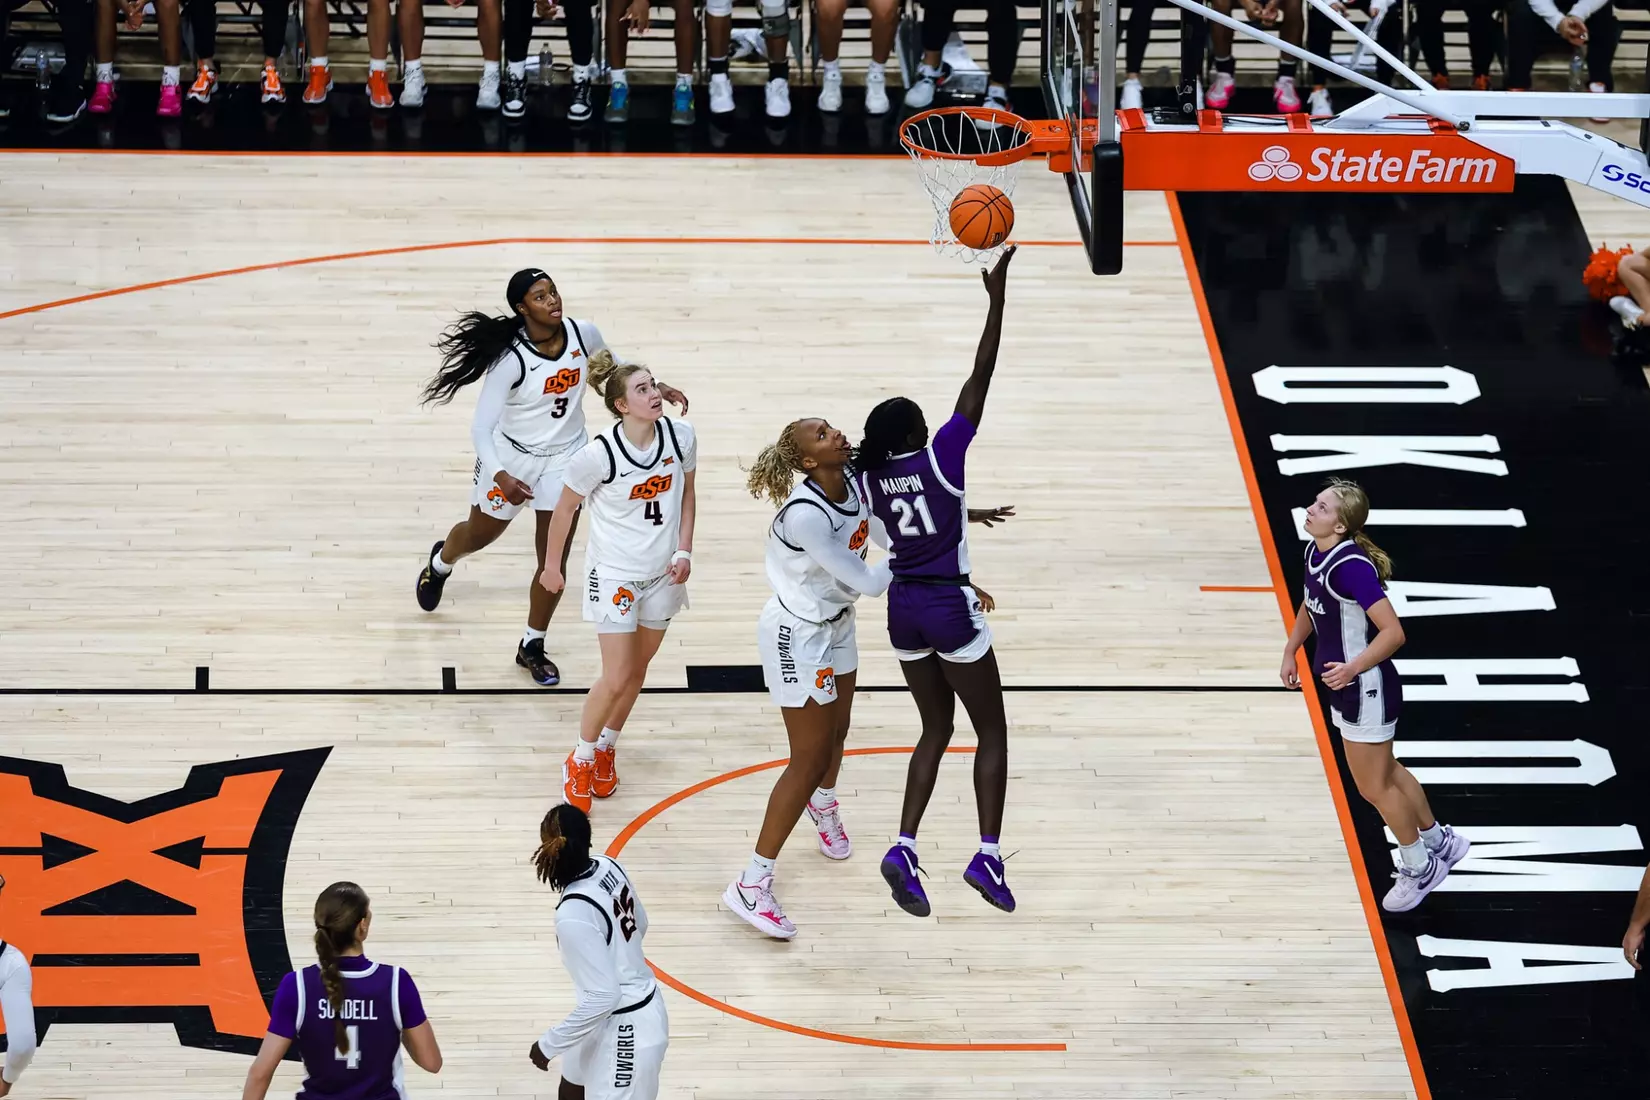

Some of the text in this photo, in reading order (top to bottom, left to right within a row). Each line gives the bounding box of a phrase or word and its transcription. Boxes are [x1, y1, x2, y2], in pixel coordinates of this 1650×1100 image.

[543, 367, 580, 395] OSU
[551, 397, 569, 419] 3
[629, 473, 673, 500] OSU
[879, 473, 924, 495] MAUPIN
[644, 500, 663, 526] 4
[890, 494, 937, 537] 21
[778, 624, 798, 684] COWGIRLS
[1252, 364, 1650, 993] OKLAHOMA
[334, 1025, 361, 1070] 4
[614, 1024, 635, 1088] COWGIRLS
